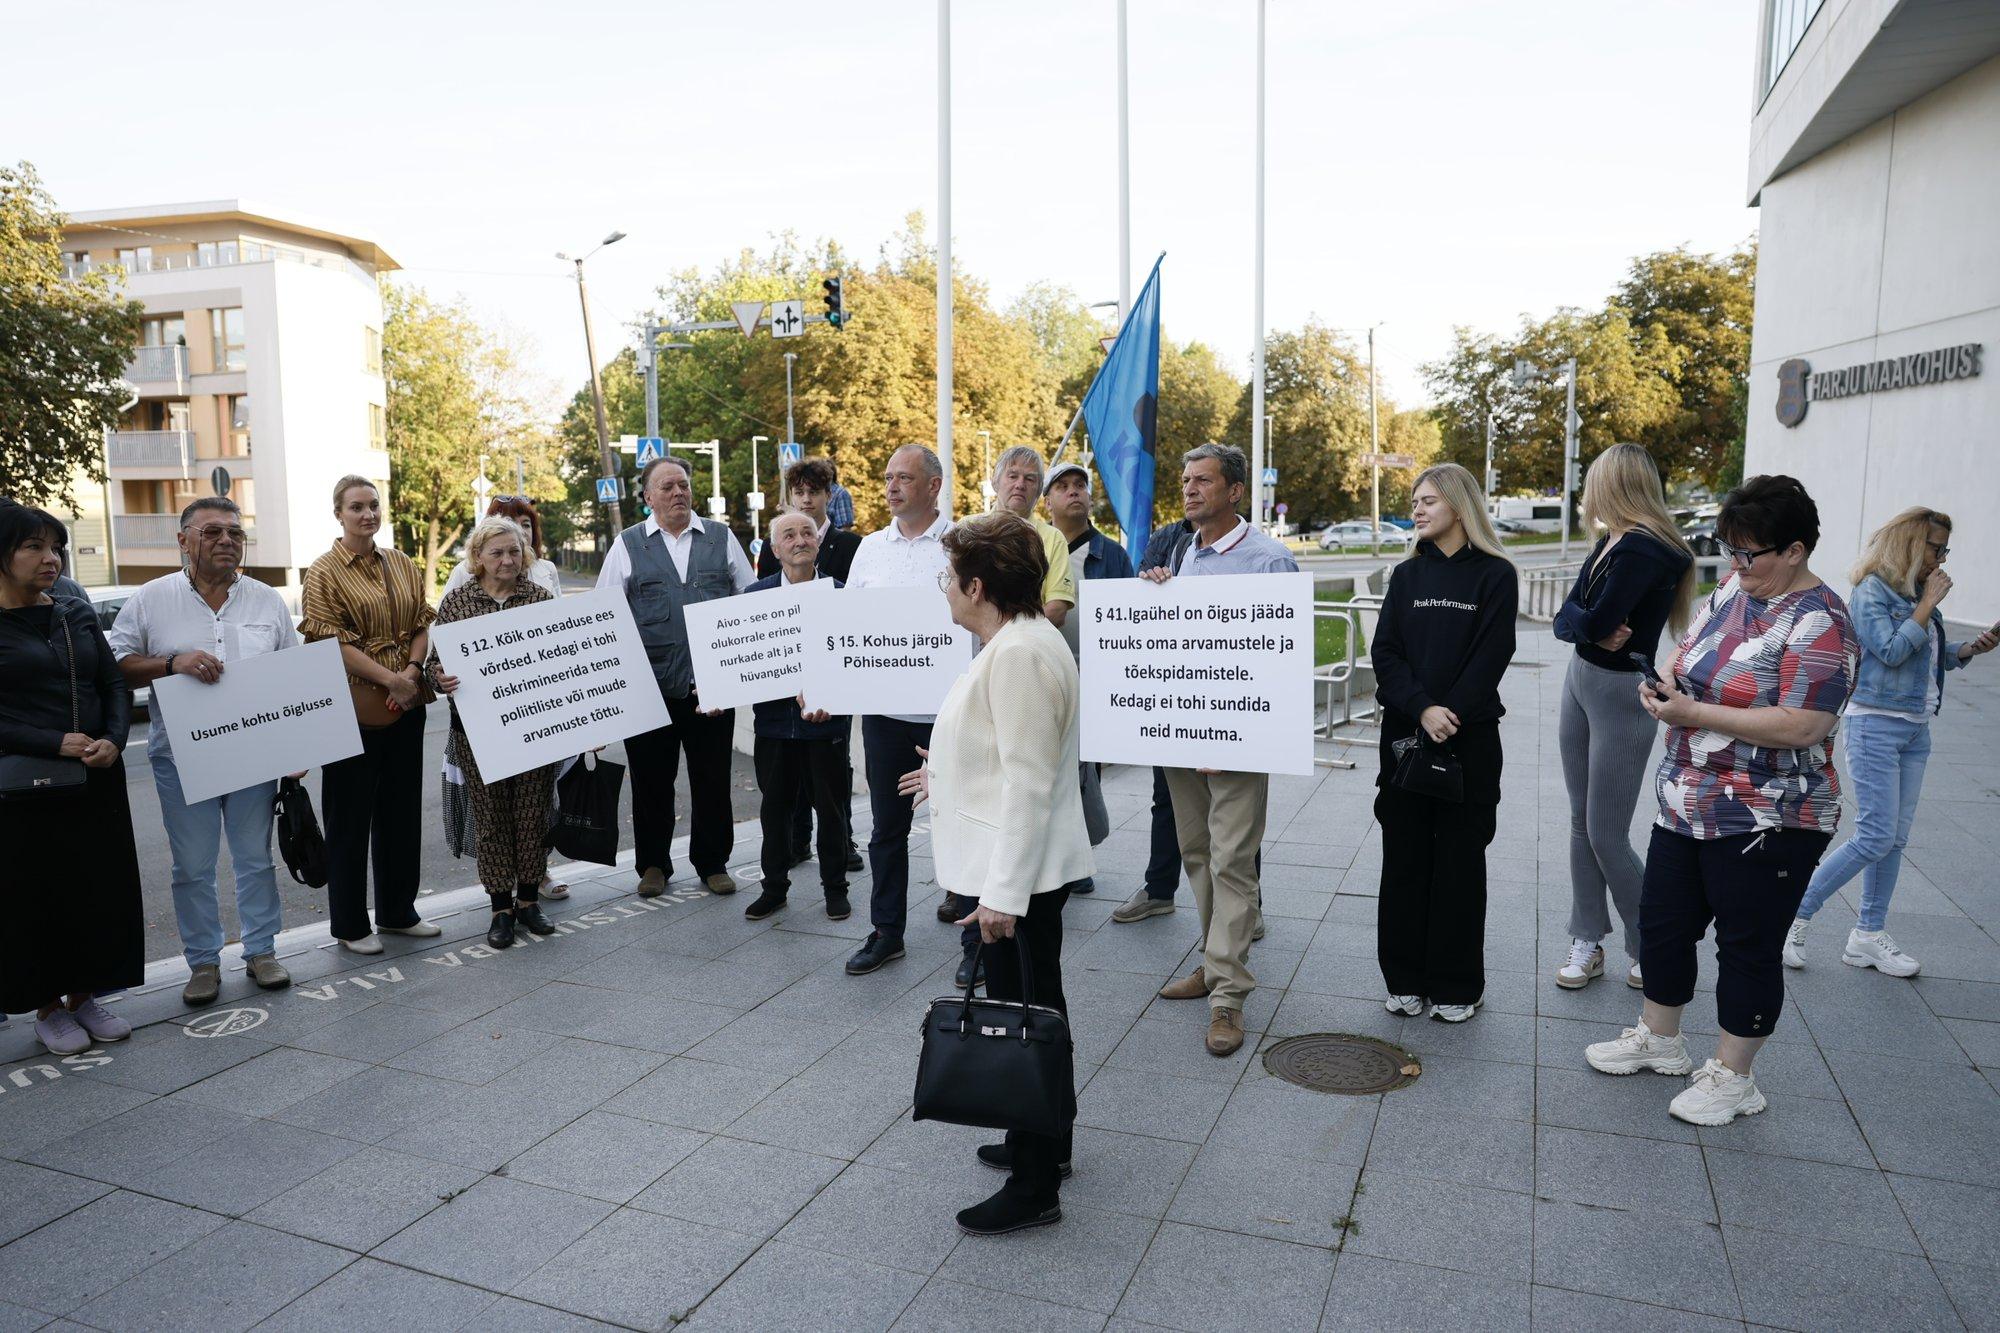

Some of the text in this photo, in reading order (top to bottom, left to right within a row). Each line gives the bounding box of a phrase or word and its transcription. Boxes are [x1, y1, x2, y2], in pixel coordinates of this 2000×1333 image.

[1811, 343, 1980, 401] HARJU MAAKOHUS
[1095, 607, 1102, 623] §
[1184, 608, 1203, 620] on
[1207, 605, 1247, 623] õigus
[1251, 604, 1294, 623] jääda
[1413, 598, 1478, 611] PeakPerformanc
[716, 617, 741, 630] Aivo
[749, 612, 768, 624] see
[771, 608, 785, 619] on
[460, 609, 615, 657] § 12. Kõik on seaduse ees
[711, 625, 802, 650] olukorrale erinev
[826, 633, 953, 652] § 15. Kohus järgib
[1098, 635, 1294, 653] truuks oma arvamustele ja
[479, 631, 617, 677] võrdsed. Kedagi ei tohi
[719, 650, 764, 668] nurkade
[766, 647, 782, 660] alt
[783, 645, 794, 658] ja
[843, 655, 934, 668] Põhiseadust.
[492, 657, 621, 699] diskrimineerida tema
[740, 662, 802, 683] hüvanguks!
[1125, 665, 1254, 682] tõekspidamistele.
[500, 678, 627, 726] poliitiliste või muude
[1110, 693, 1271, 712] Kedagi ei tohi sundida
[190, 697, 333, 741] Usume kohtu õiglusse
[522, 706, 624, 743] arvamuste tõttu.
[1140, 723, 1243, 742] neid muutma.
[296, 966, 405, 1001] ALA
